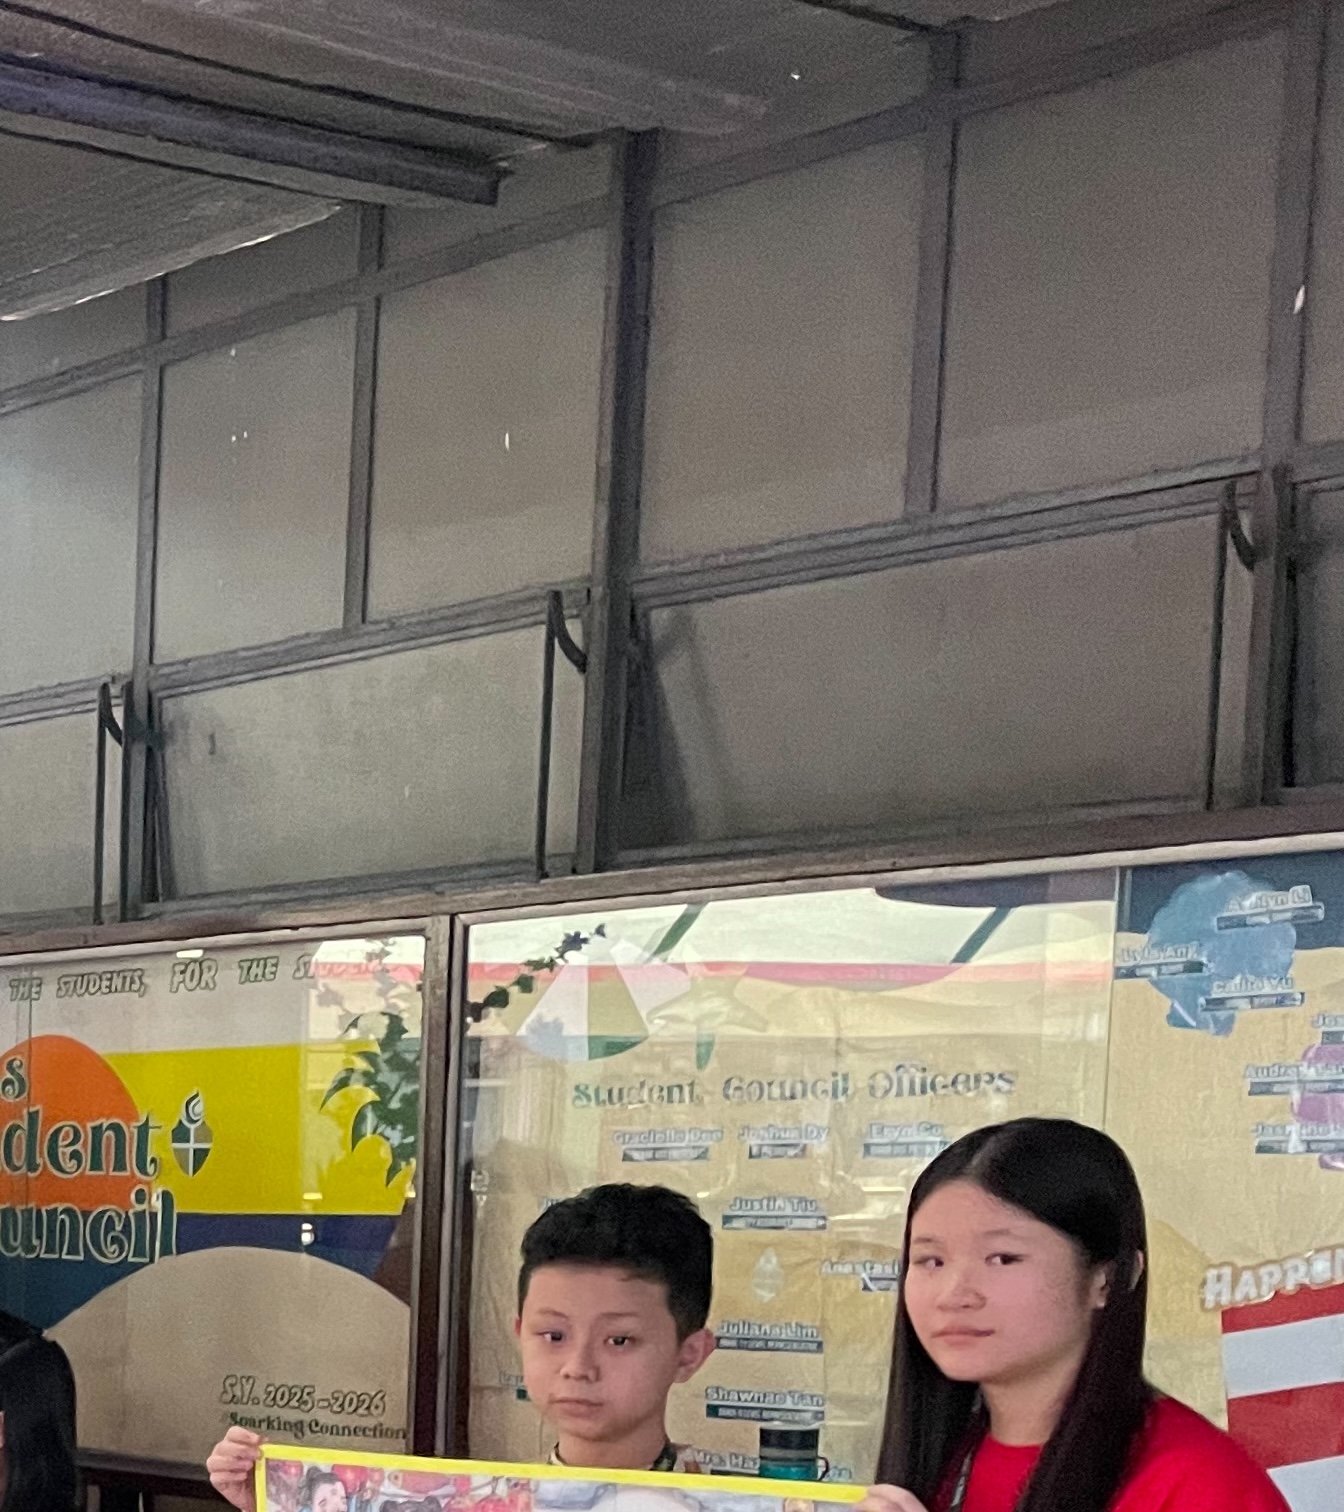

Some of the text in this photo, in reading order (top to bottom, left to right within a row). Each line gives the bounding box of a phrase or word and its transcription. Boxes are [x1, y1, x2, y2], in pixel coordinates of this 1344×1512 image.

[9, 976, 43, 1002] THE
[56, 968, 148, 998] STUDENTS,
[169, 957, 218, 994] FOR
[237, 955, 281, 985] THE
[572, 1061, 1017, 1109] Student Council Officers
[729, 1196, 786, 1212] Justin
[221, 1374, 260, 1406] S.Y.
